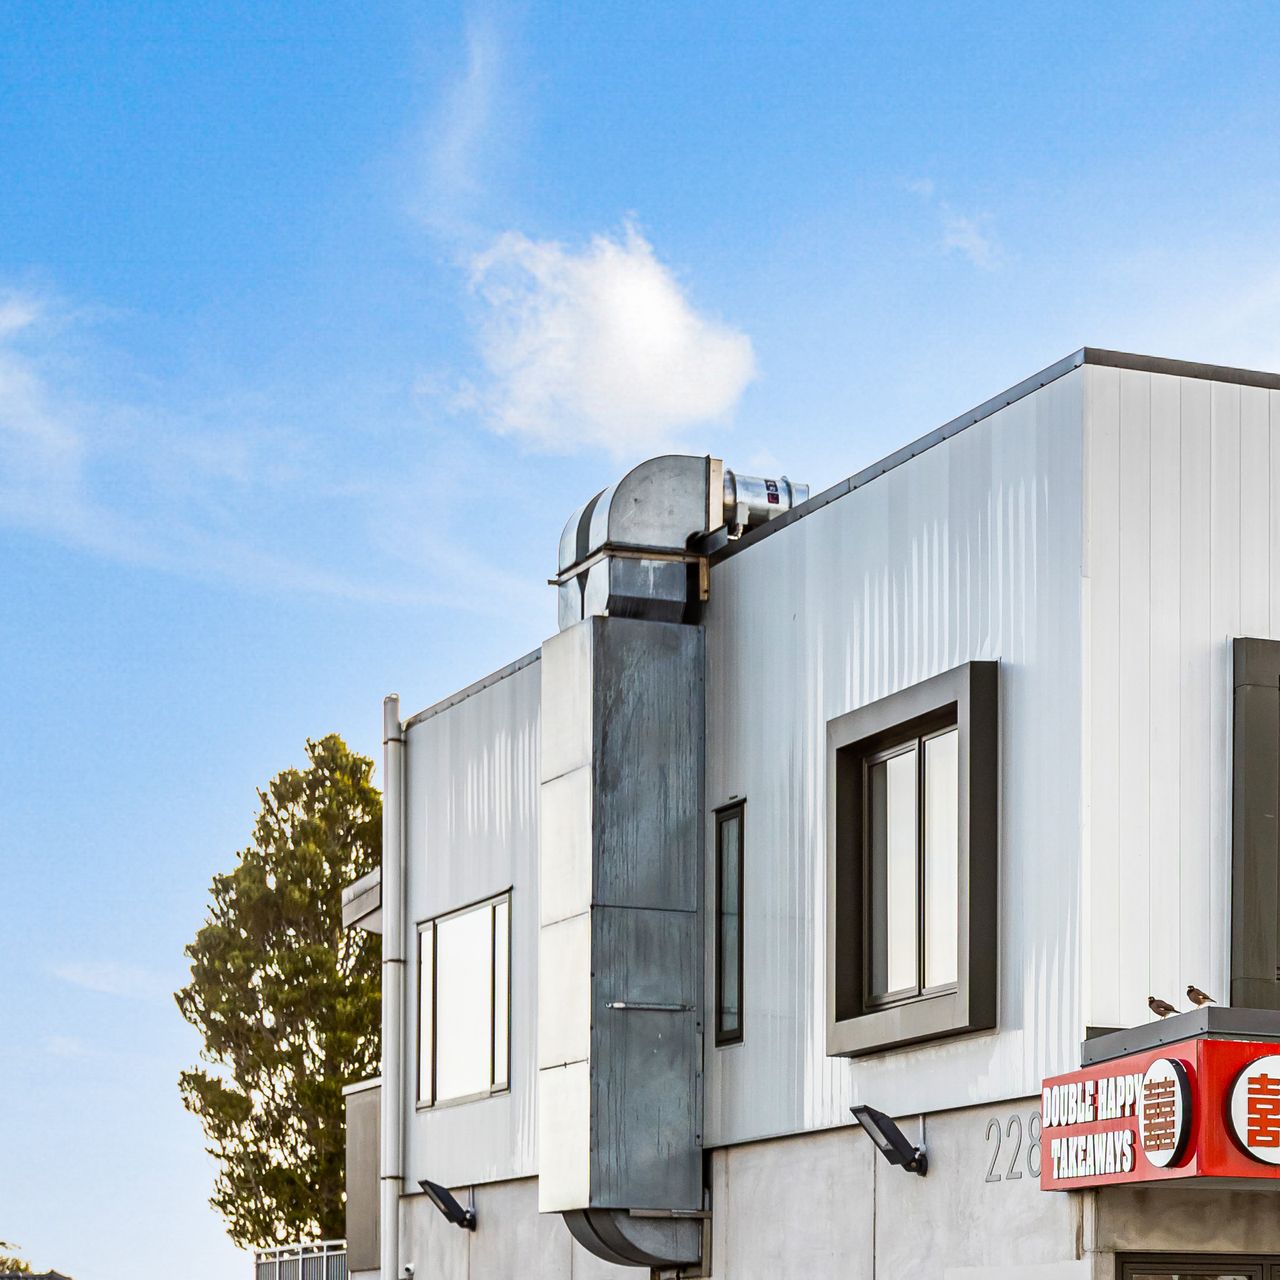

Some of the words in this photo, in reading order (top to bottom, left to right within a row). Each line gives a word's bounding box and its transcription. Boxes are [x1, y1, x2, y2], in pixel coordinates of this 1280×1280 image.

[1043, 1080, 1095, 1128] DOUBLE
[1097, 1073, 1145, 1121] HAPPY
[985, 1111, 1042, 1183] 228
[1051, 1129, 1135, 1180] TAKEAWAYS
